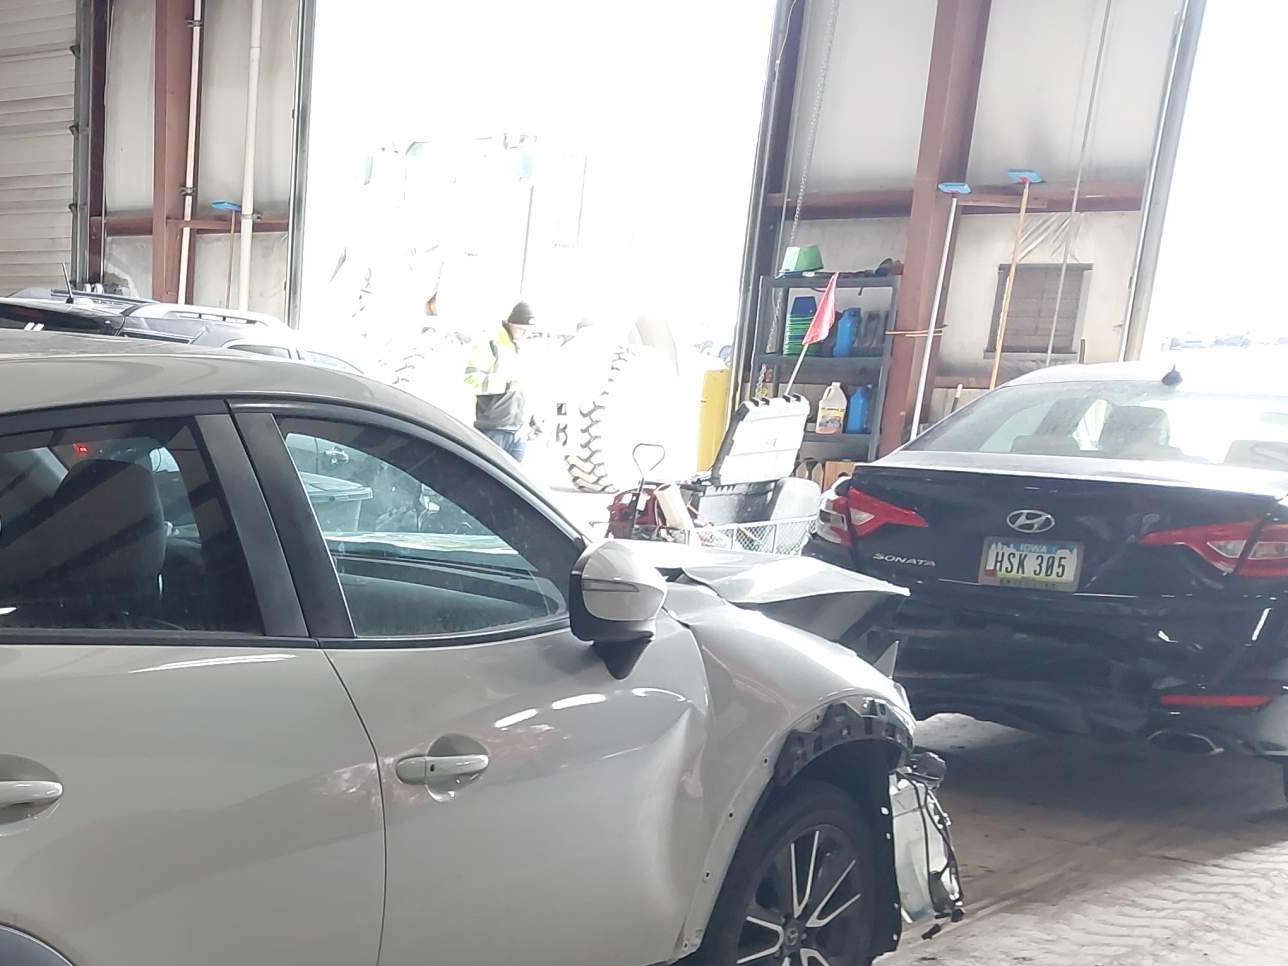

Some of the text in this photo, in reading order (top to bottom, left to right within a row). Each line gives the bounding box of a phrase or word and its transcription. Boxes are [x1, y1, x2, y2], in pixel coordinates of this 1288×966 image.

[1020, 543, 1048, 554] IOWA
[872, 552, 937, 567] SONATA
[993, 551, 1068, 578] HSK 305
